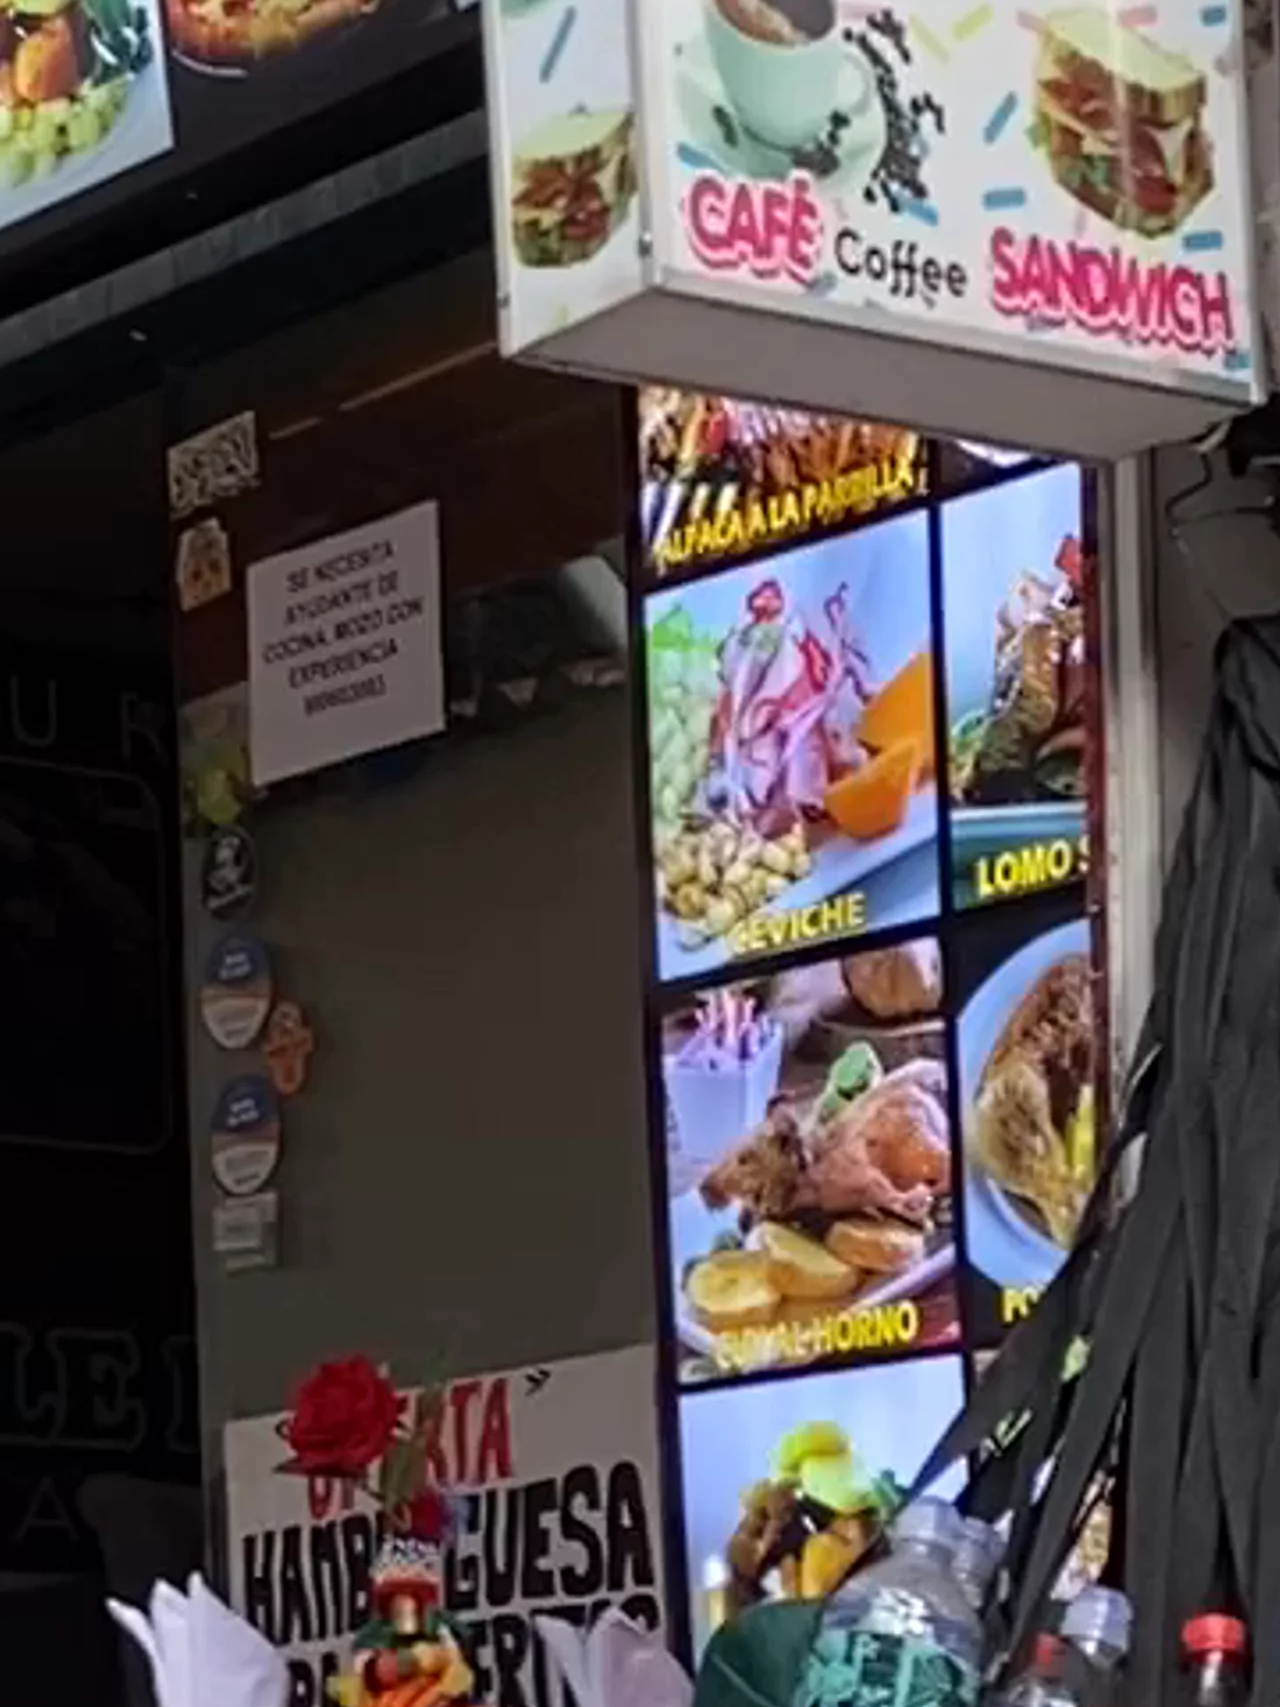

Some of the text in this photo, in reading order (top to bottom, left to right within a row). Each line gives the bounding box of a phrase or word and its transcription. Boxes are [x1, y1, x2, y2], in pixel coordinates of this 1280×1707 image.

[684, 169, 820, 291] CAFÉ
[833, 228, 968, 301] Coffee
[988, 229, 1232, 351] SANDWICH
[977, 839, 1074, 897] LOMO
[733, 891, 867, 952] CEVICHE
[821, 1300, 918, 1352] HORNO
